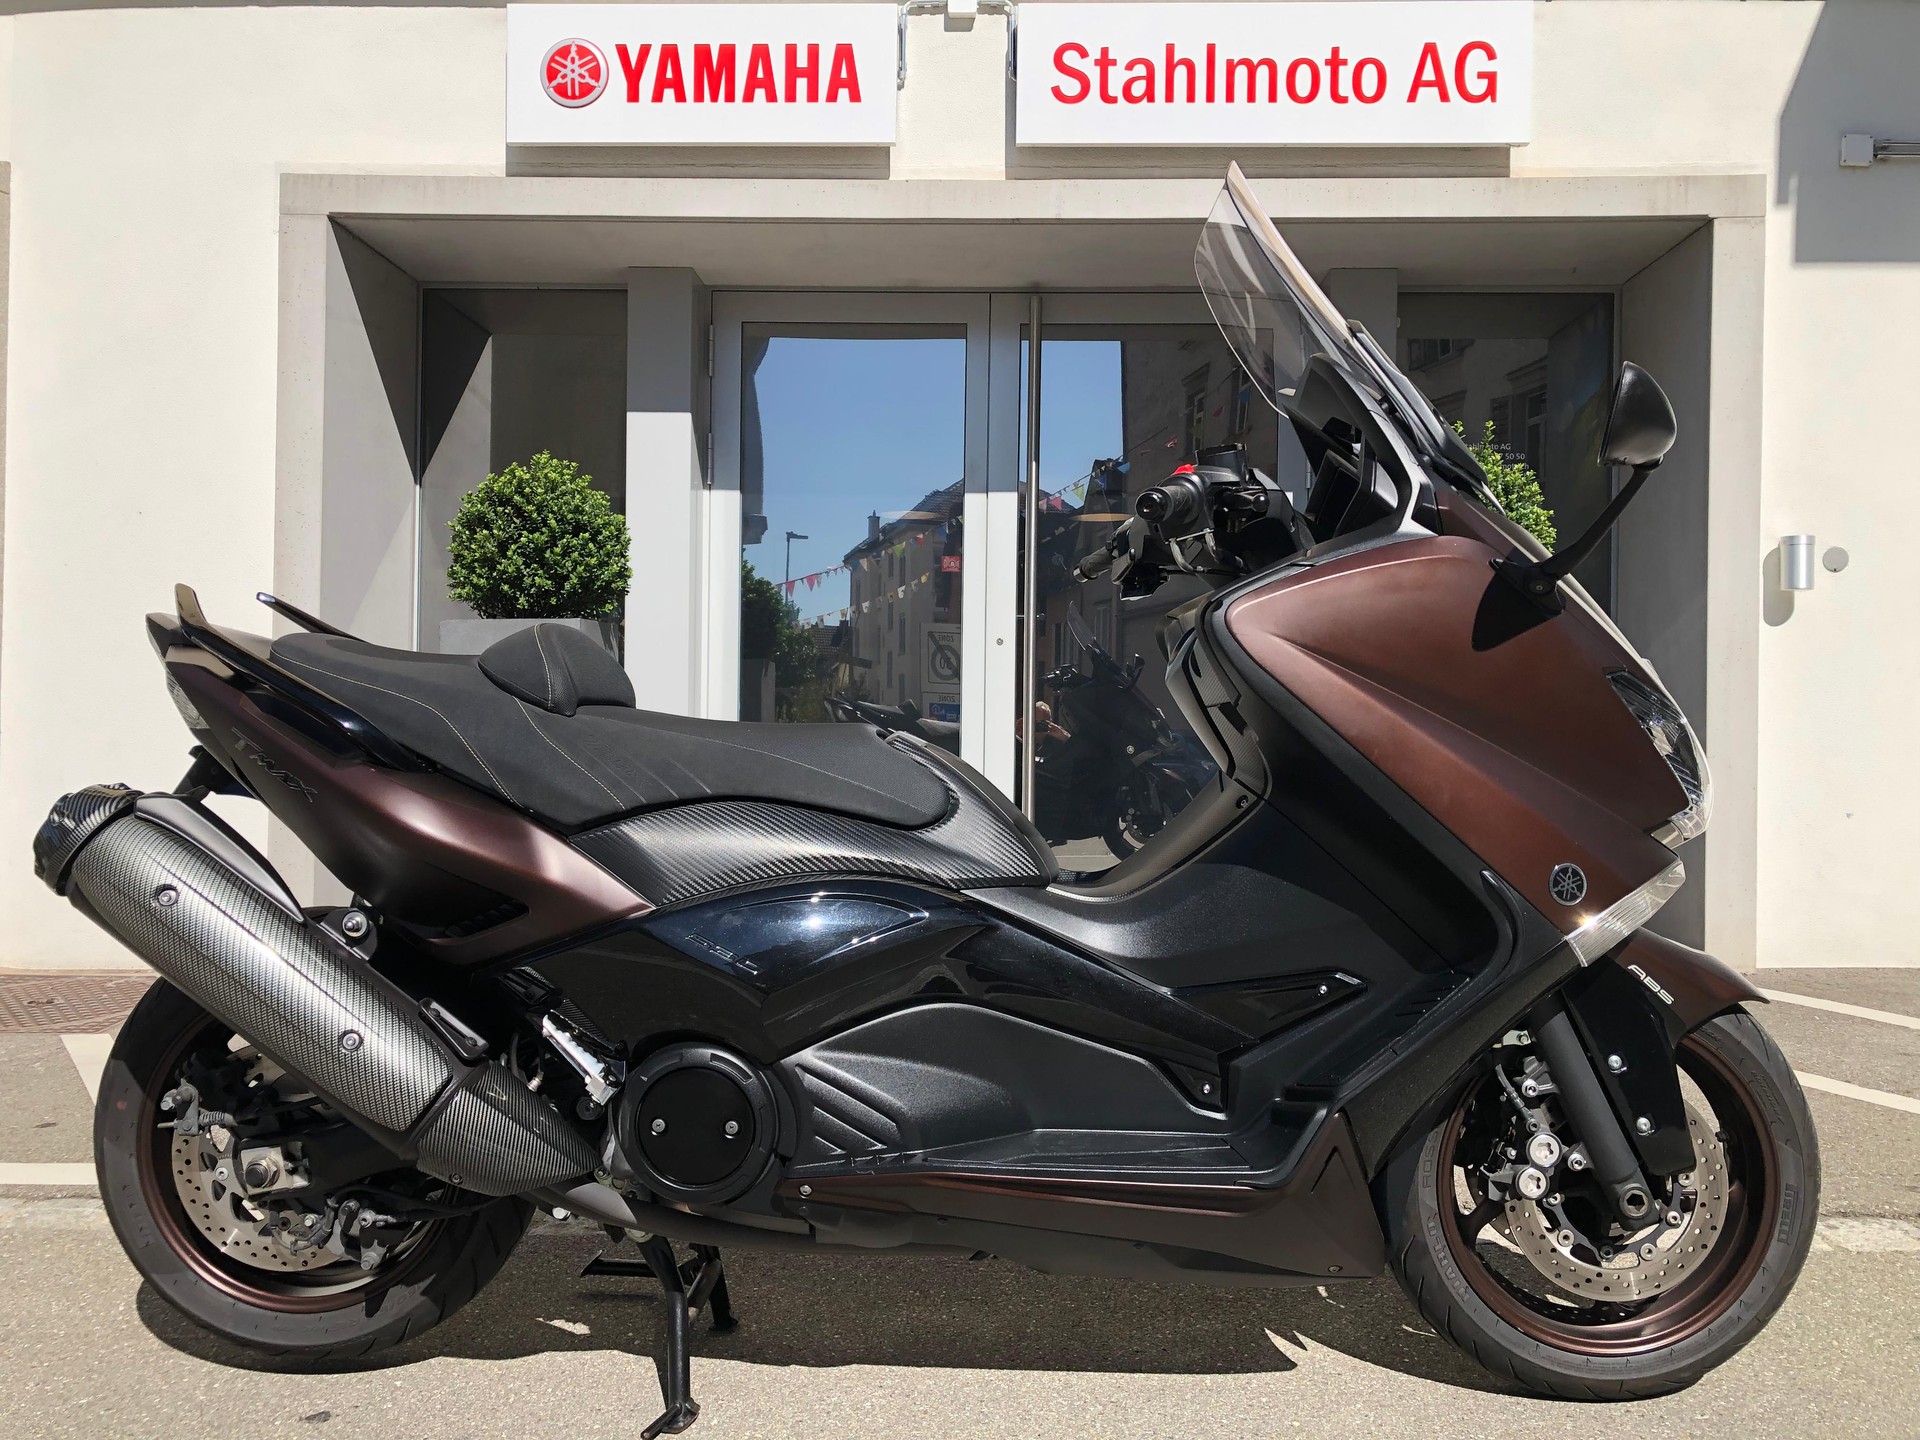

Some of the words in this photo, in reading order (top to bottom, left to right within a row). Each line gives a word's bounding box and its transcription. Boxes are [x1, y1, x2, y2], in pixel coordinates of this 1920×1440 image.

[616, 43, 862, 104] YAMAHA
[1050, 42, 1388, 105] Stahlmoto
[1406, 42, 1498, 105] AG
[1627, 964, 1675, 1005] ABS
[1776, 1183, 1799, 1246] PIRELLI
[1426, 1220, 1471, 1304] DIABLO
